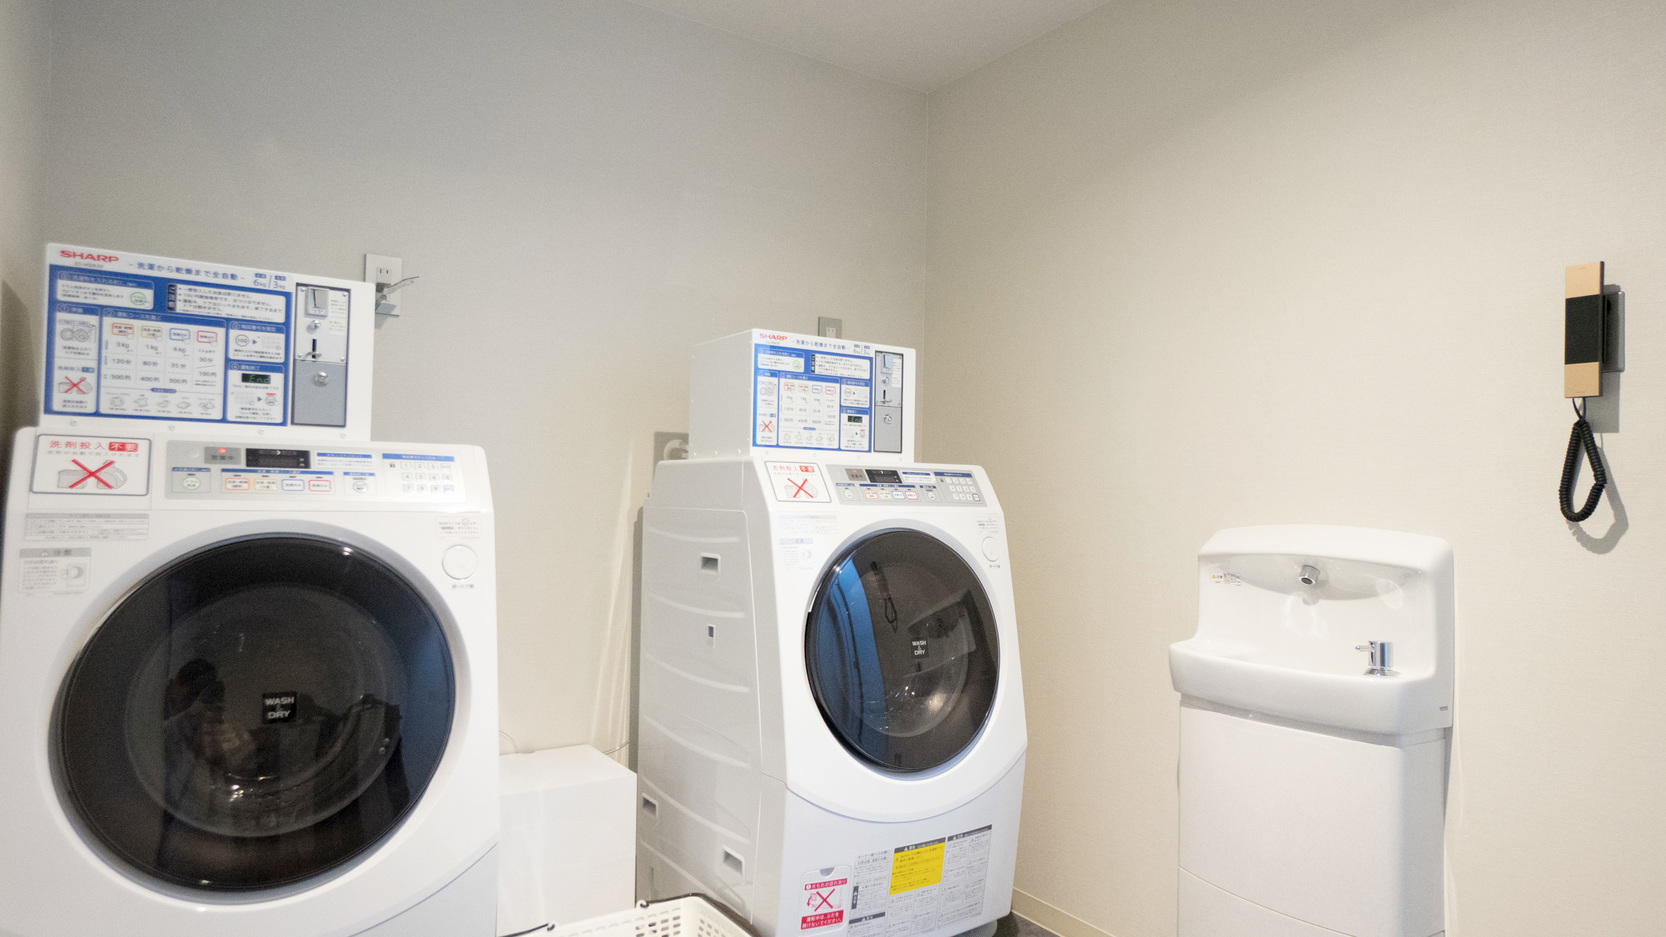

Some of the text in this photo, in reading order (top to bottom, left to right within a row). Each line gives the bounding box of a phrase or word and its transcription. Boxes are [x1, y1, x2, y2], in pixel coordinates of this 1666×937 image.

[59, 250, 119, 262] SHARP
[759, 332, 788, 341] SHARP
[50, 440, 138, 452] 洗剤投入 不要
[265, 696, 295, 706] WASH
[267, 710, 291, 719] DRY
